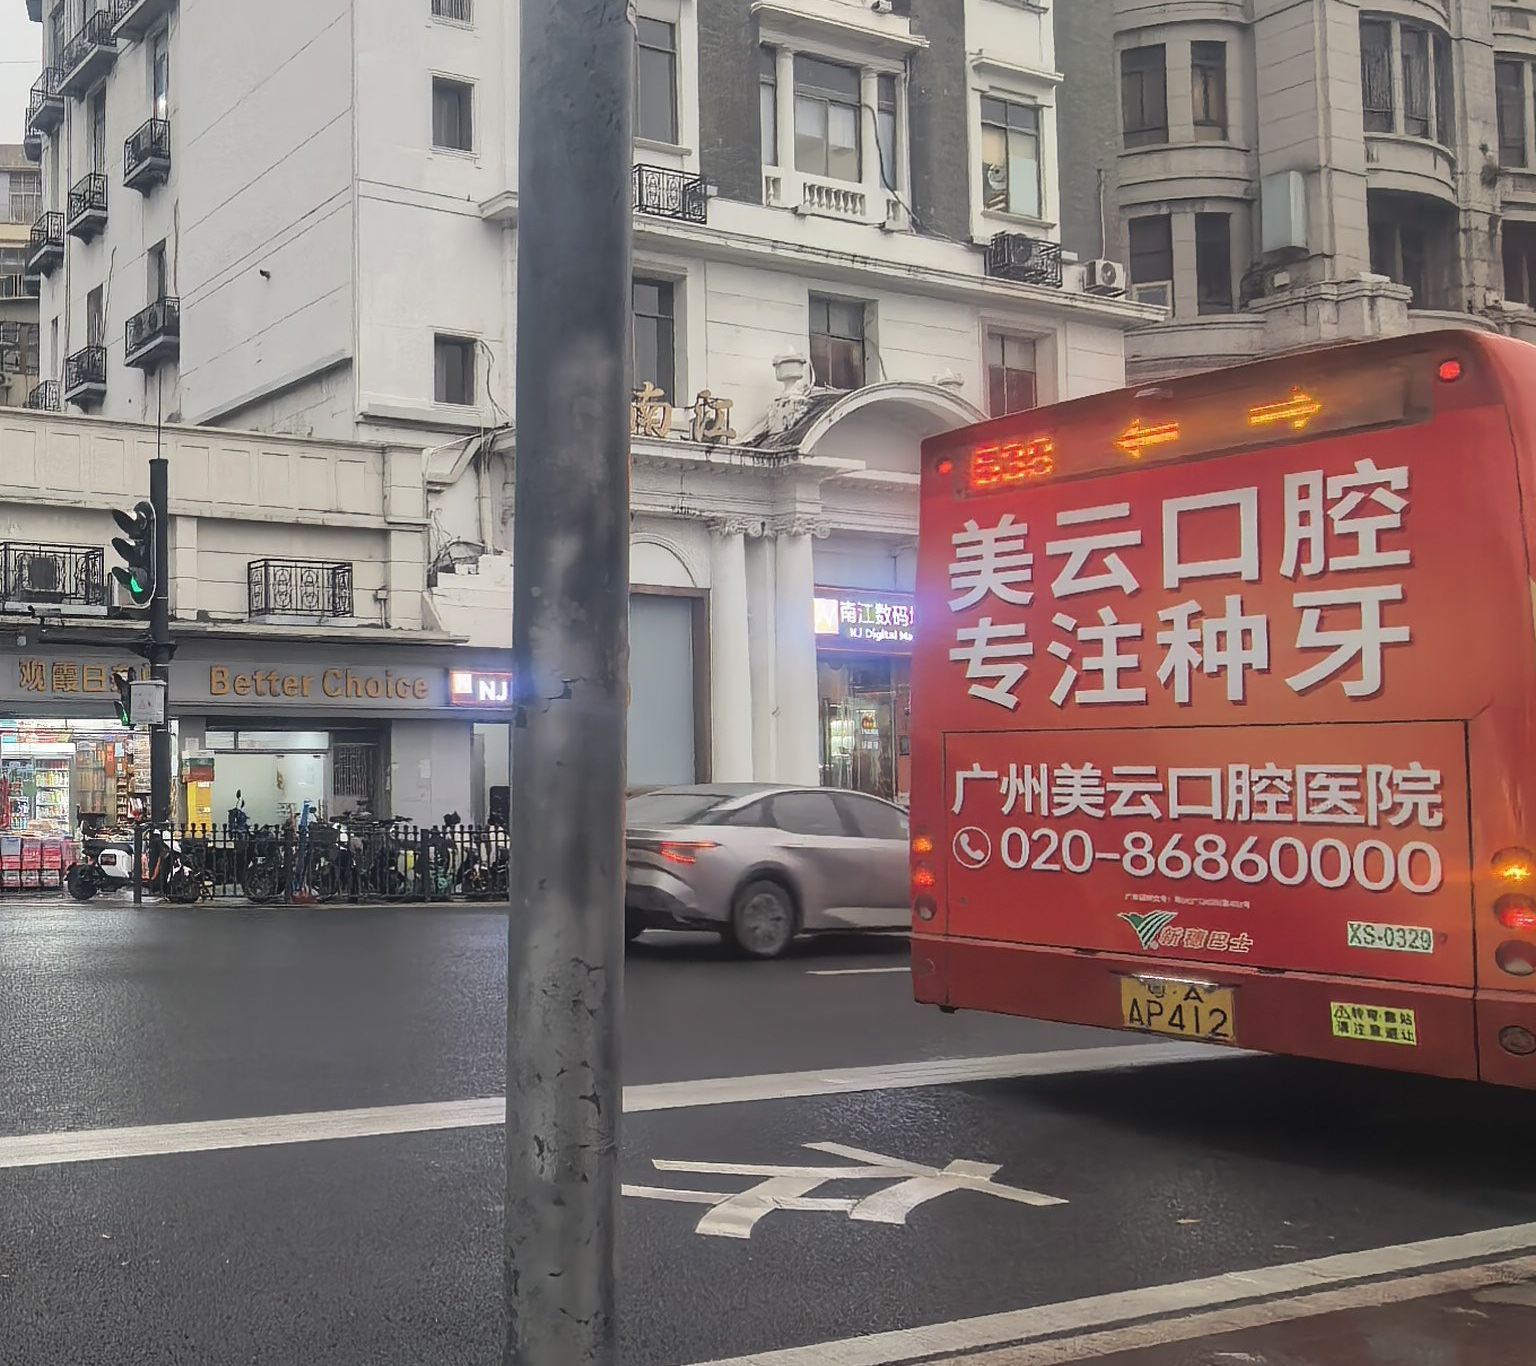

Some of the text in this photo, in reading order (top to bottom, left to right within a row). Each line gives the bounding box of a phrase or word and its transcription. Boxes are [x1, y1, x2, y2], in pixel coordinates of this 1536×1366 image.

[630, 381, 736, 443] 南江
[949, 458, 1411, 612] 美云口腔
[840, 600, 913, 627] 南江数码
[865, 628, 898, 642] Digital
[950, 584, 1410, 710] 专注种牙
[209, 665, 429, 699] Better Choice
[479, 680, 509, 701] NJ
[952, 762, 1443, 827] 广州美云口腔医院
[1001, 827, 1443, 893] 020-86860000
[1129, 998, 1231, 1037] AP412
